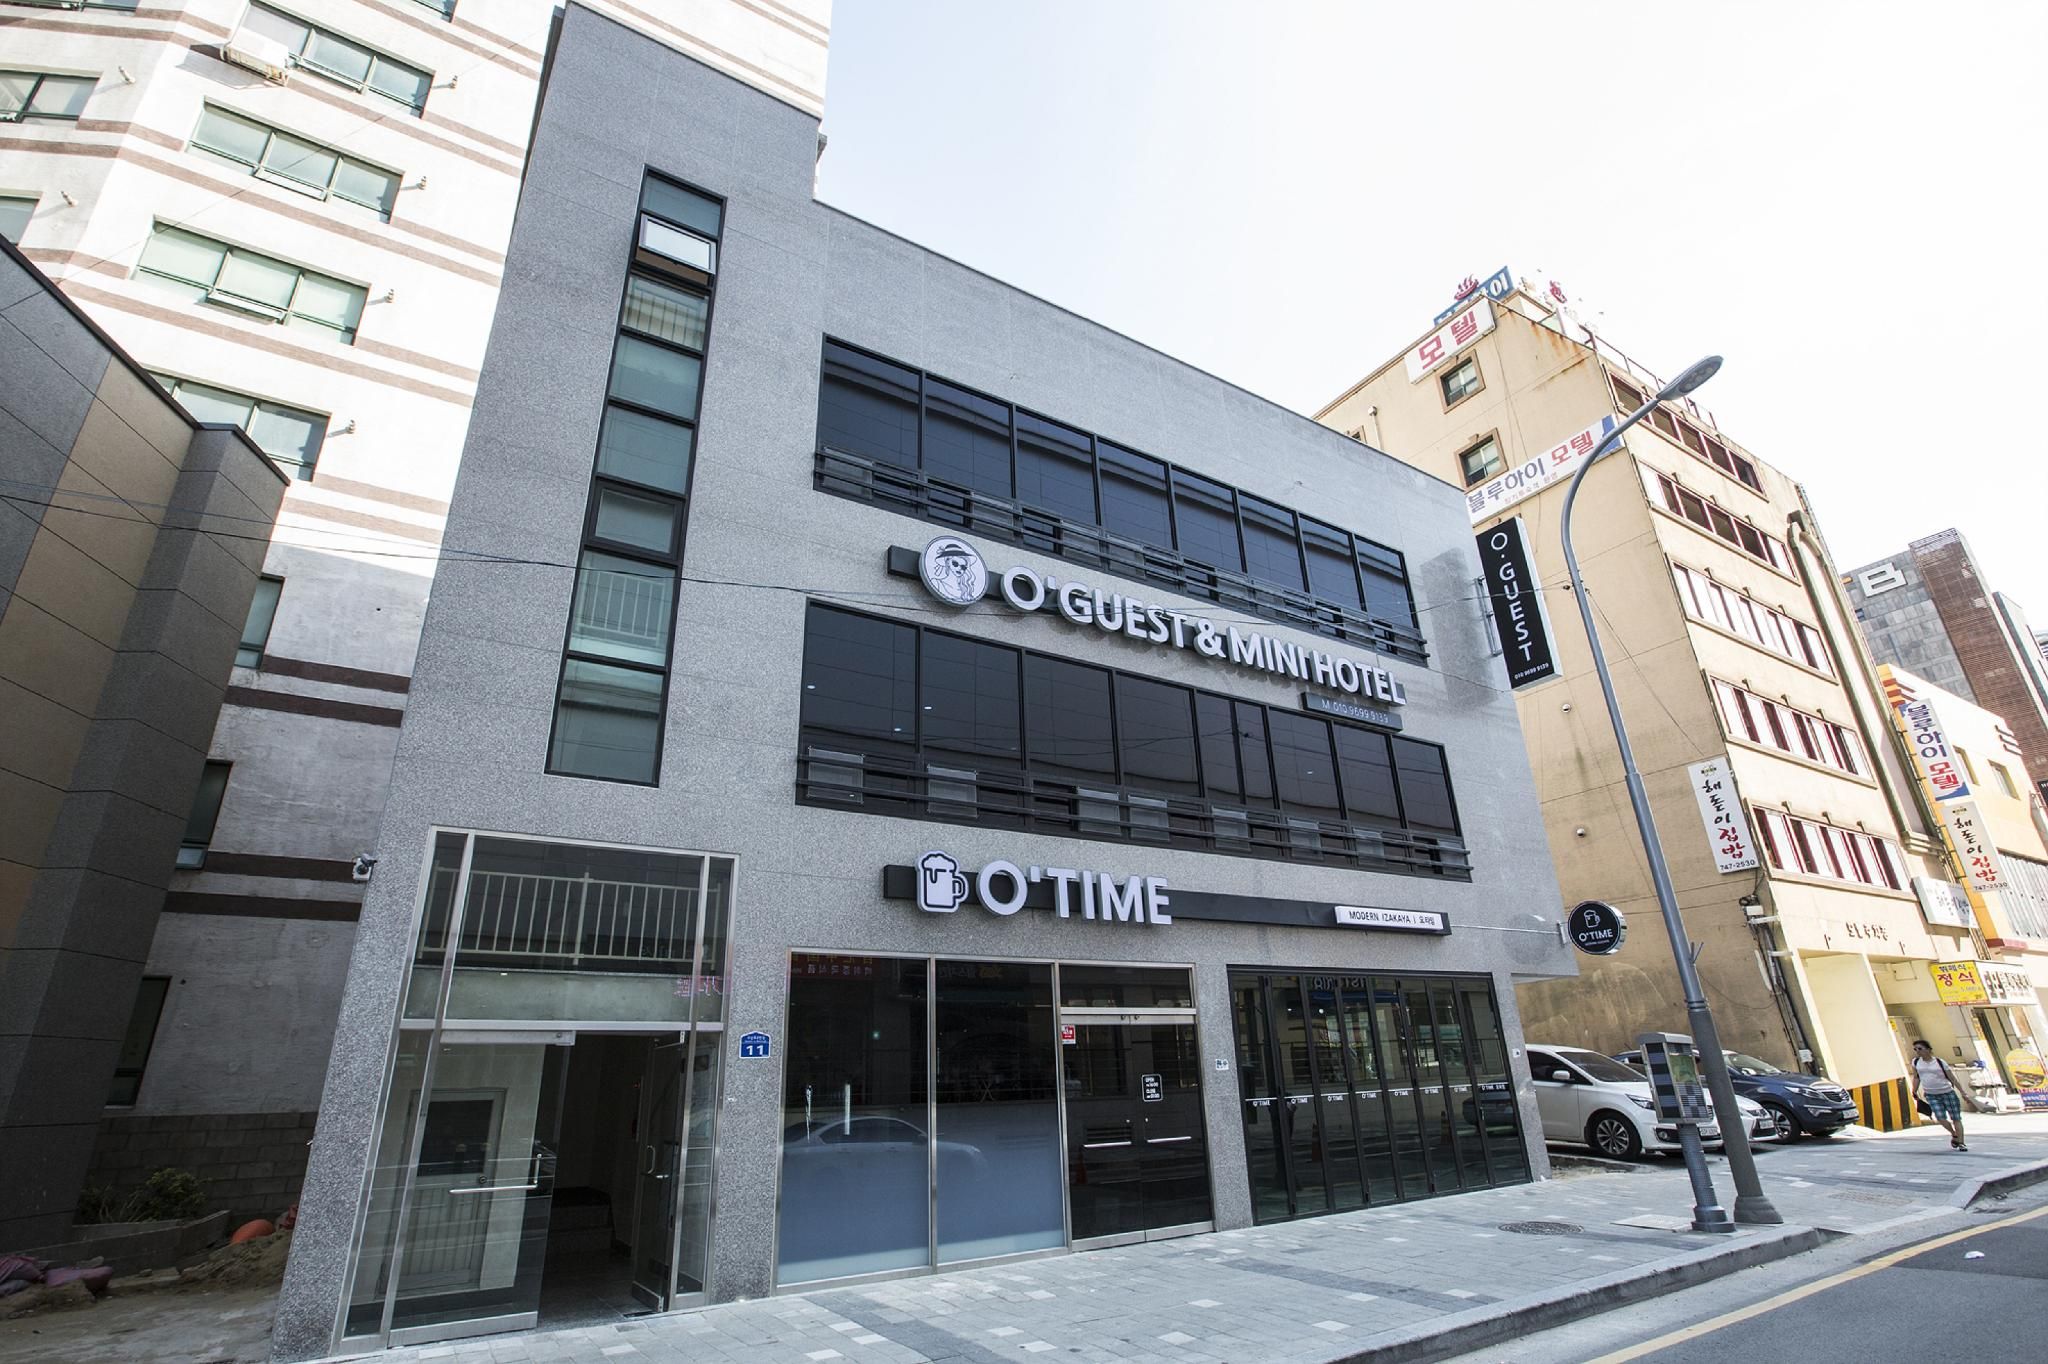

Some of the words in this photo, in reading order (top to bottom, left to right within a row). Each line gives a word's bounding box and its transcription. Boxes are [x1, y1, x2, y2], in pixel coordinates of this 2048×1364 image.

[1419, 311, 1477, 370] 모텔
[1468, 457, 1545, 514] 블루아이
[1551, 430, 1594, 468] 모텔
[1001, 565, 1187, 650] O'GUEST
[1194, 618, 1225, 659] &
[1226, 626, 1308, 680] MINI
[1309, 653, 1407, 706] HOTEL
[1333, 702, 1347, 713] 010
[1349, 706, 1369, 718] 9699
[1907, 704, 1948, 758] 블루아이
[1929, 761, 1961, 790] 모텔
[1718, 826, 1745, 859] 집밥
[1720, 860, 1756, 871] 747-2530
[1972, 855, 1998, 882] 집밥
[975, 860, 1173, 926] O'TIME
[1974, 882, 2008, 891] 747-2530
[1349, 910, 1379, 921] MODERN
[1381, 913, 1411, 924] IZAKAYA
[1578, 928, 1614, 942] O'TIME
[1938, 971, 1976, 987] 정식
[746, 1045, 764, 1056] 11
